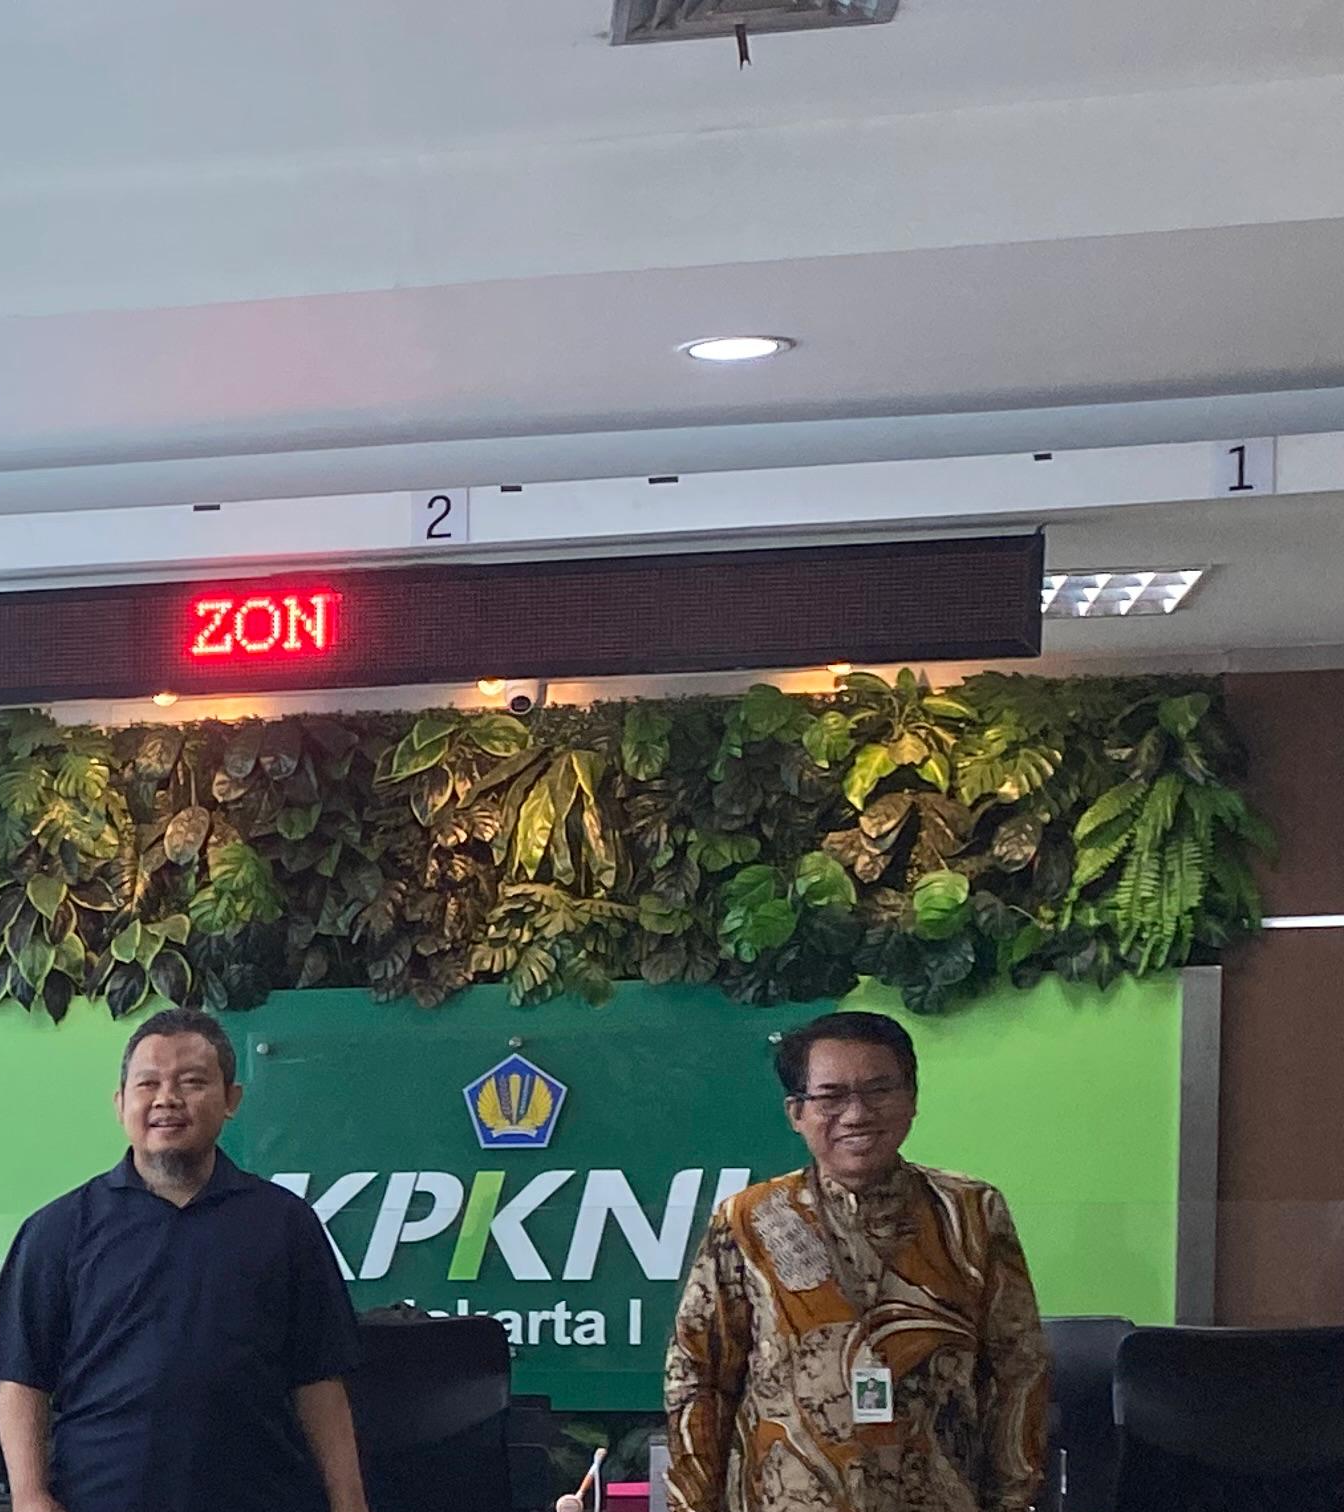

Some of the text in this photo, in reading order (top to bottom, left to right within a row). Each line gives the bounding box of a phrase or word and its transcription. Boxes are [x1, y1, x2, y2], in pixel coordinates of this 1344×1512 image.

[1228, 444, 1255, 492] 1
[425, 493, 453, 541] 2
[190, 593, 328, 657] ZON
[403, 1298, 643, 1346] arta I
